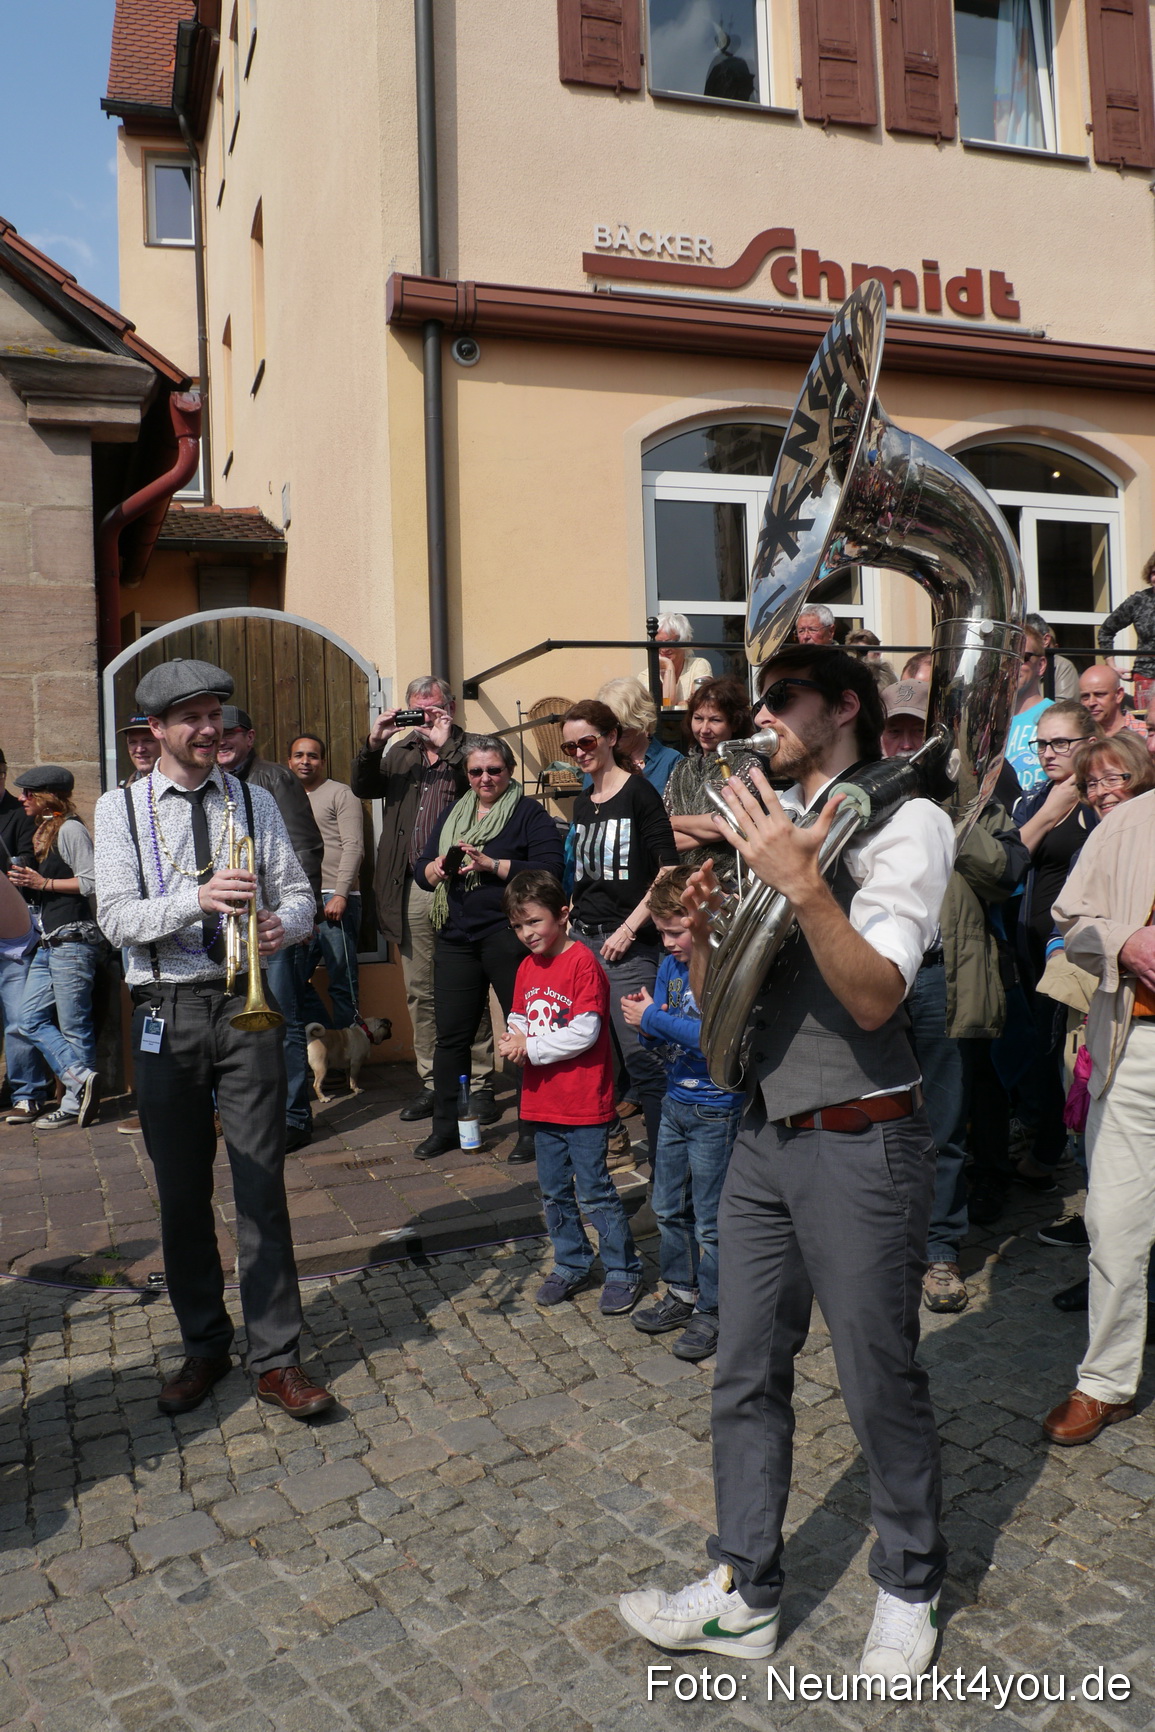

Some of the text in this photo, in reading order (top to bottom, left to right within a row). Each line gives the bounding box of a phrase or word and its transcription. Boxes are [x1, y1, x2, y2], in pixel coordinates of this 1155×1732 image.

[593, 223, 713, 259] BÄCKER
[582, 227, 1020, 319] Schmidt
[524, 986, 573, 1007] unior Jones
